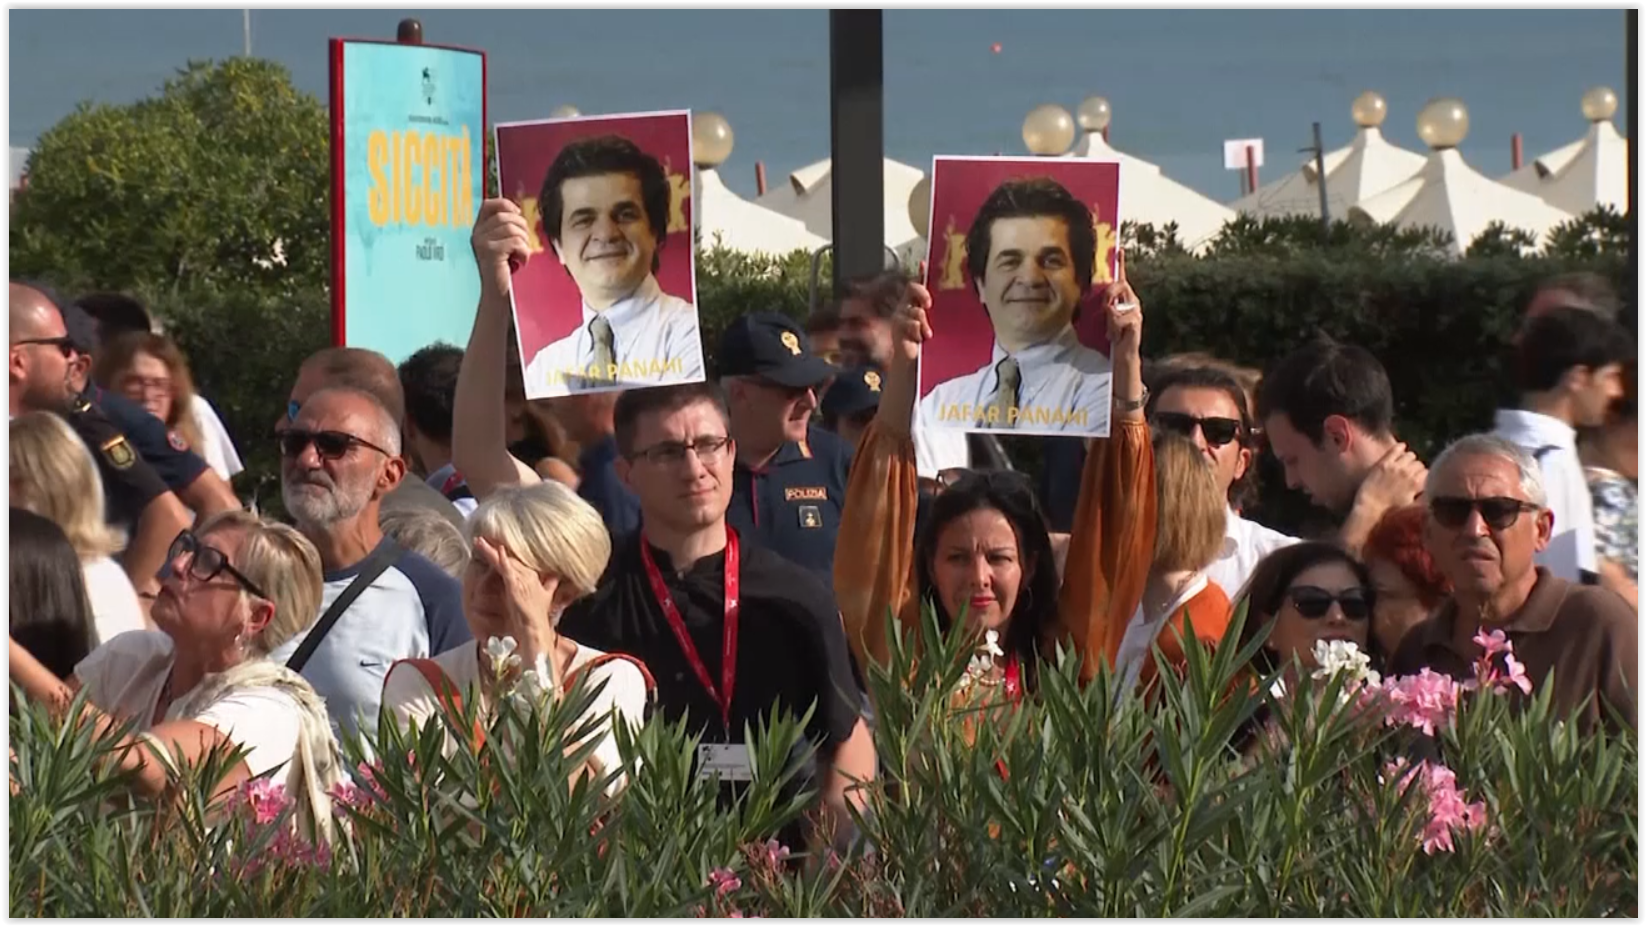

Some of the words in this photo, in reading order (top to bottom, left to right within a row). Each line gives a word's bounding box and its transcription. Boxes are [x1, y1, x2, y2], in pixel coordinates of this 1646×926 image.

[368, 124, 473, 228] SICCITÀ
[546, 364, 601, 386] JAFAR
[608, 357, 683, 380] PANAHI
[939, 404, 1000, 422] JAFAR
[1007, 406, 1089, 427] PANAHI
